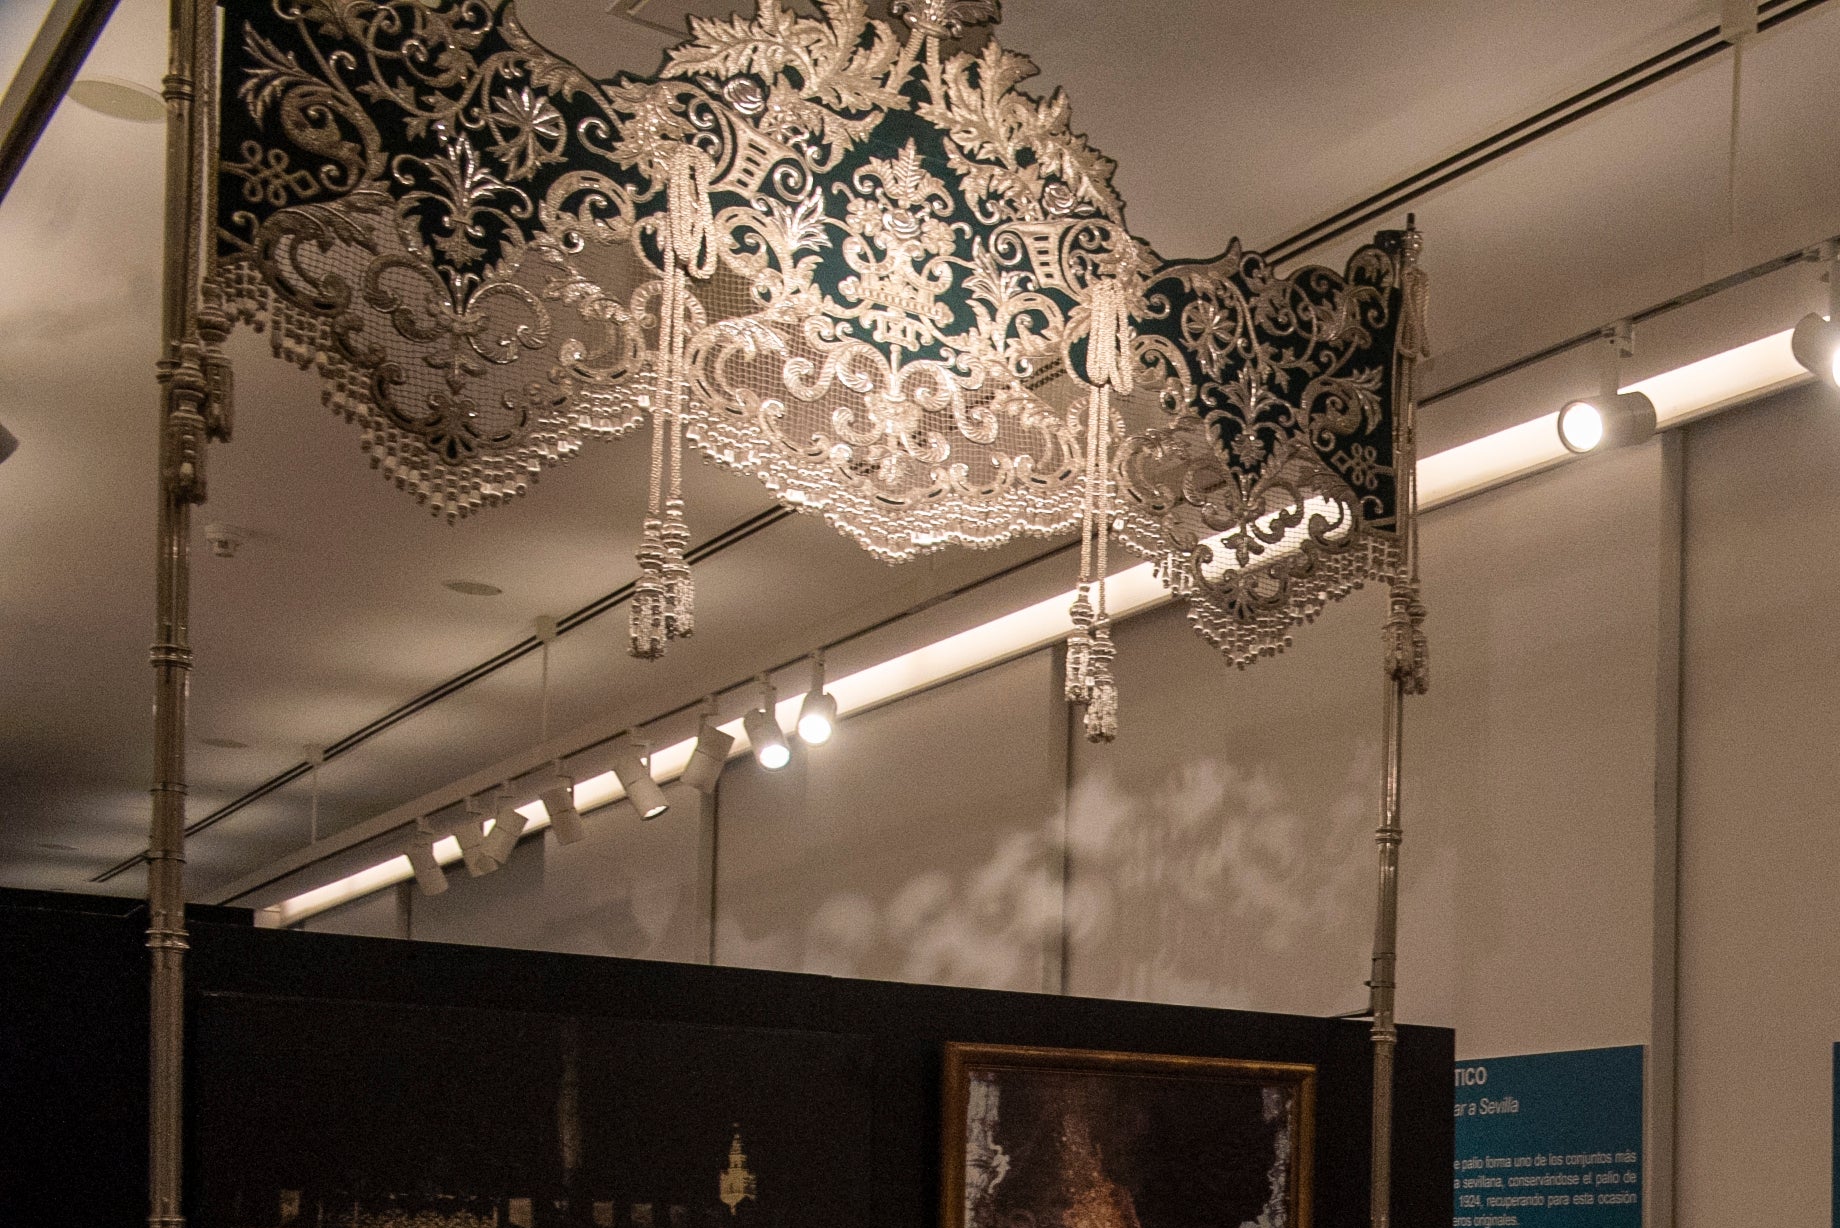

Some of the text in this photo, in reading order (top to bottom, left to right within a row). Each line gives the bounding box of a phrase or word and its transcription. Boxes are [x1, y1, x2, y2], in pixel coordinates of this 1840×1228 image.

[1468, 1102, 1476, 1116] a
[1479, 1096, 1519, 1115] Sevilla
[1462, 1156, 1483, 1172] palio
[1486, 1155, 1511, 1168] forma
[1514, 1156, 1532, 1167] uno
[1534, 1153, 1547, 1166] de
[1549, 1153, 1563, 1165] los
[1566, 1151, 1612, 1168] conjuntos
[1583, 1171, 1592, 1184] el
[1596, 1171, 1620, 1187] palio
[1623, 1170, 1637, 1183] de
[1487, 1193, 1545, 1209] recuperando
[1548, 1195, 1570, 1208] para
[1573, 1192, 1594, 1205] esta
